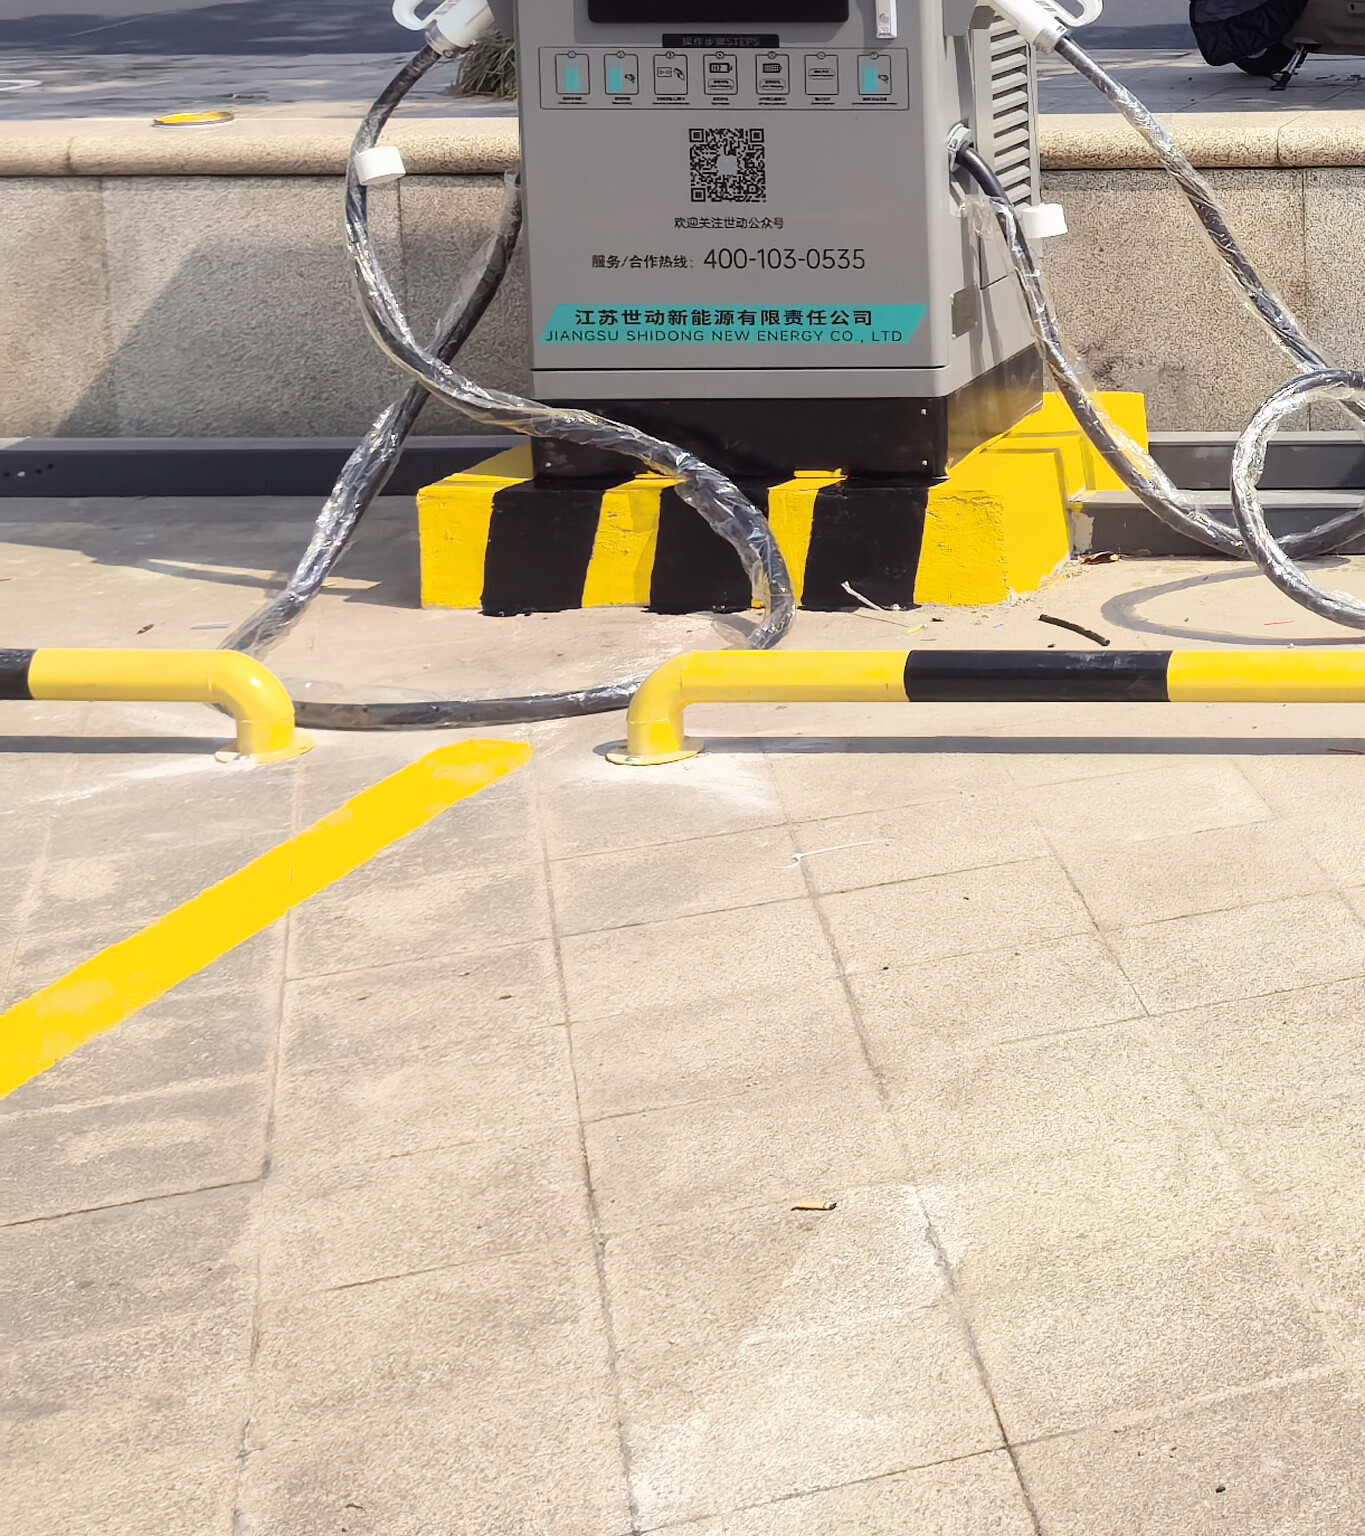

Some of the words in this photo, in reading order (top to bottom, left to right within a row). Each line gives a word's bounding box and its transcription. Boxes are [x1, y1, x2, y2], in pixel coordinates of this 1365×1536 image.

[674, 216, 784, 230] 欢迎关注世动公众号
[703, 248, 866, 270] 400-103-0535
[575, 309, 873, 327] 江苏世动新能源有限责任公司
[545, 330, 620, 343] JIANGSU
[626, 330, 705, 343] SHIDONG
[712, 330, 750, 343] NEW
[757, 330, 824, 343] ENERGY
[871, 330, 903, 343] LTD
